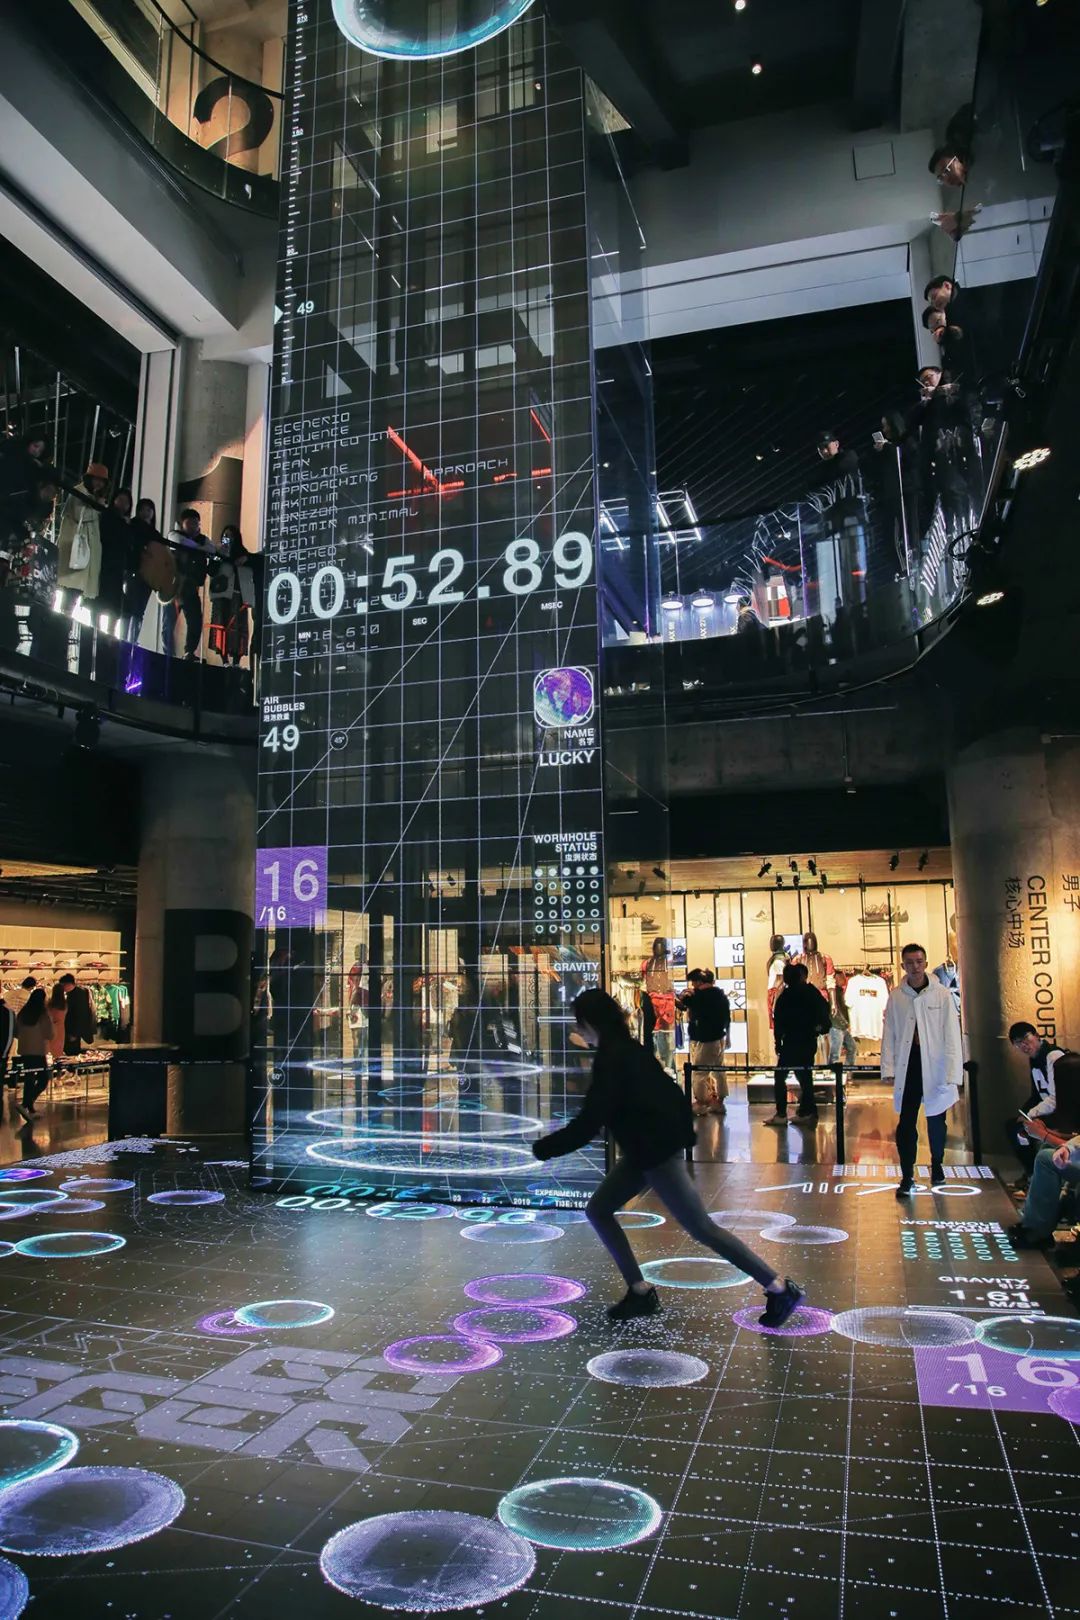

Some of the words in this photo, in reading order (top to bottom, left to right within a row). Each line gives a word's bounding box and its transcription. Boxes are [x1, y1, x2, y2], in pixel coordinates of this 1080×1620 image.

[297, 300, 316, 314] 49
[274, 425, 349, 447] SEQUENCE
[273, 464, 348, 485] TIMELINE
[423, 458, 508, 479] APPROACH
[272, 472, 378, 497] APPROACHING
[270, 519, 338, 538] CASIMIR
[347, 508, 418, 525] MINIMAL
[270, 536, 317, 550] POINT
[269, 546, 337, 564] REACHED
[266, 531, 595, 625] 00:52.89
[412, 616, 428, 625] SEC
[540, 600, 563, 610] MSEC
[263, 696, 280, 705] AIR
[263, 702, 306, 714] BUBBLES
[262, 724, 300, 753] 49
[563, 728, 595, 739] NAME
[539, 750, 595, 767] LUCKY
[534, 832, 597, 844] WORMHOLE
[555, 842, 597, 853] STATUS
[263, 859, 320, 903] 16
[259, 906, 287, 921] /16
[1004, 876, 1025, 949] 核心中场
[1027, 875, 1051, 966] CENTER
[553, 962, 599, 972] GRAVITY
[938, 1276, 1028, 1285] GRAVITY
[949, 1290, 1030, 1303] 1.61
[946, 1352, 1080, 1387] 16
[947, 1383, 1007, 1397] /16
